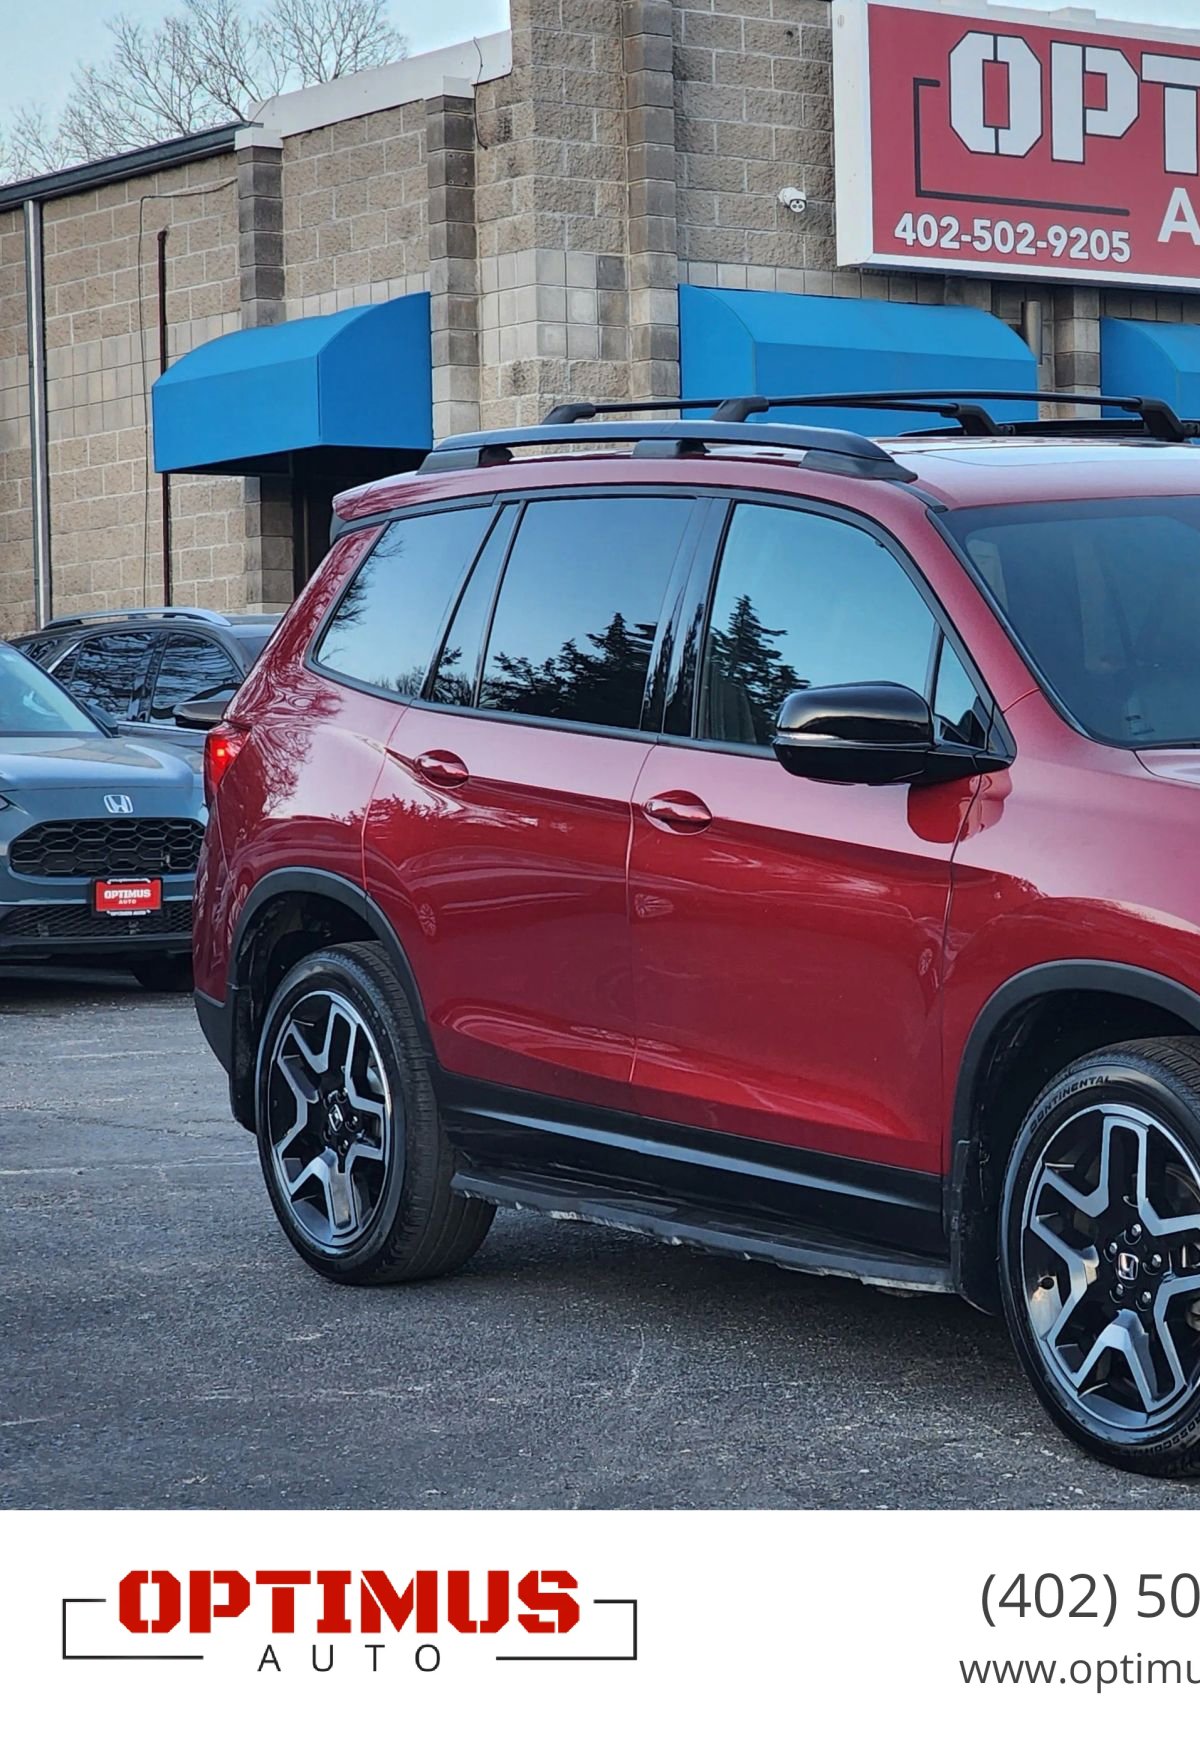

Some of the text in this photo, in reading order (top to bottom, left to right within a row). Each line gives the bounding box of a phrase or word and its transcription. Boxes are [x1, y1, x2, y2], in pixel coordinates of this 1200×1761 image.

[894, 212, 1131, 263] 402-502-9205
[104, 889, 152, 899] OPTIMUS
[1029, 1075, 1111, 1134] CONTINENTAL
